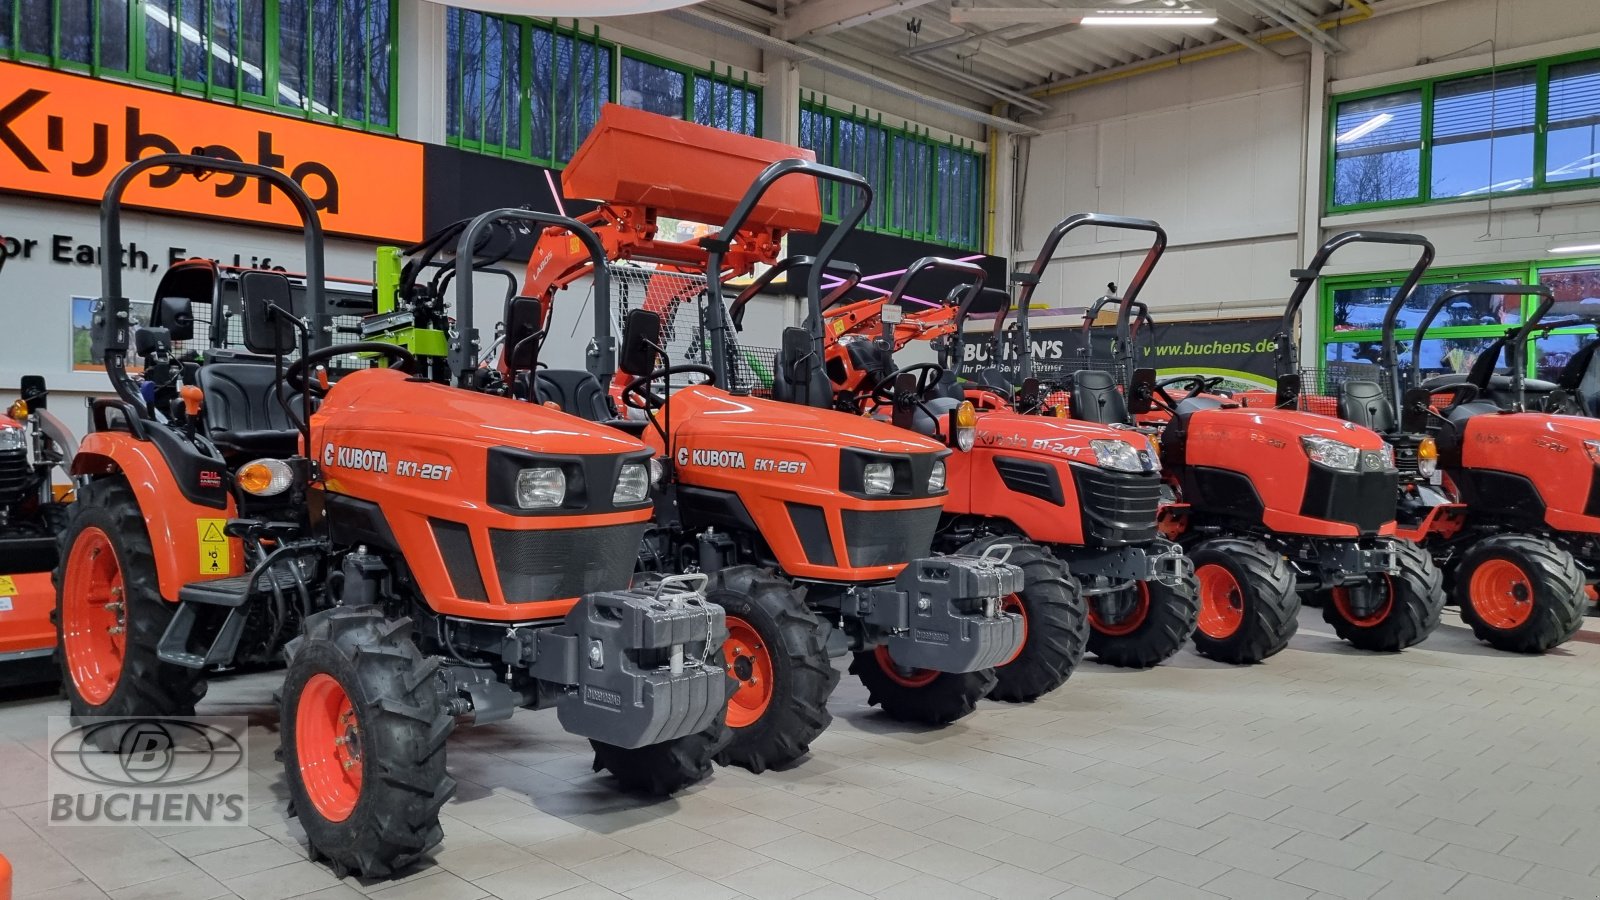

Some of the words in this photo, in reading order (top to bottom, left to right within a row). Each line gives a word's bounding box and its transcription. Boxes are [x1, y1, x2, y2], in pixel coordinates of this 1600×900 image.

[0, 88, 340, 215] Kubota
[4, 235, 38, 259] or
[963, 340, 1064, 362] BUHN'S
[962, 364, 974, 374] Ihr
[337, 446, 388, 474] KUBOTA
[396, 460, 453, 481] EK1-261
[692, 449, 746, 469] KUBOTA
[753, 458, 808, 475] EK1-261
